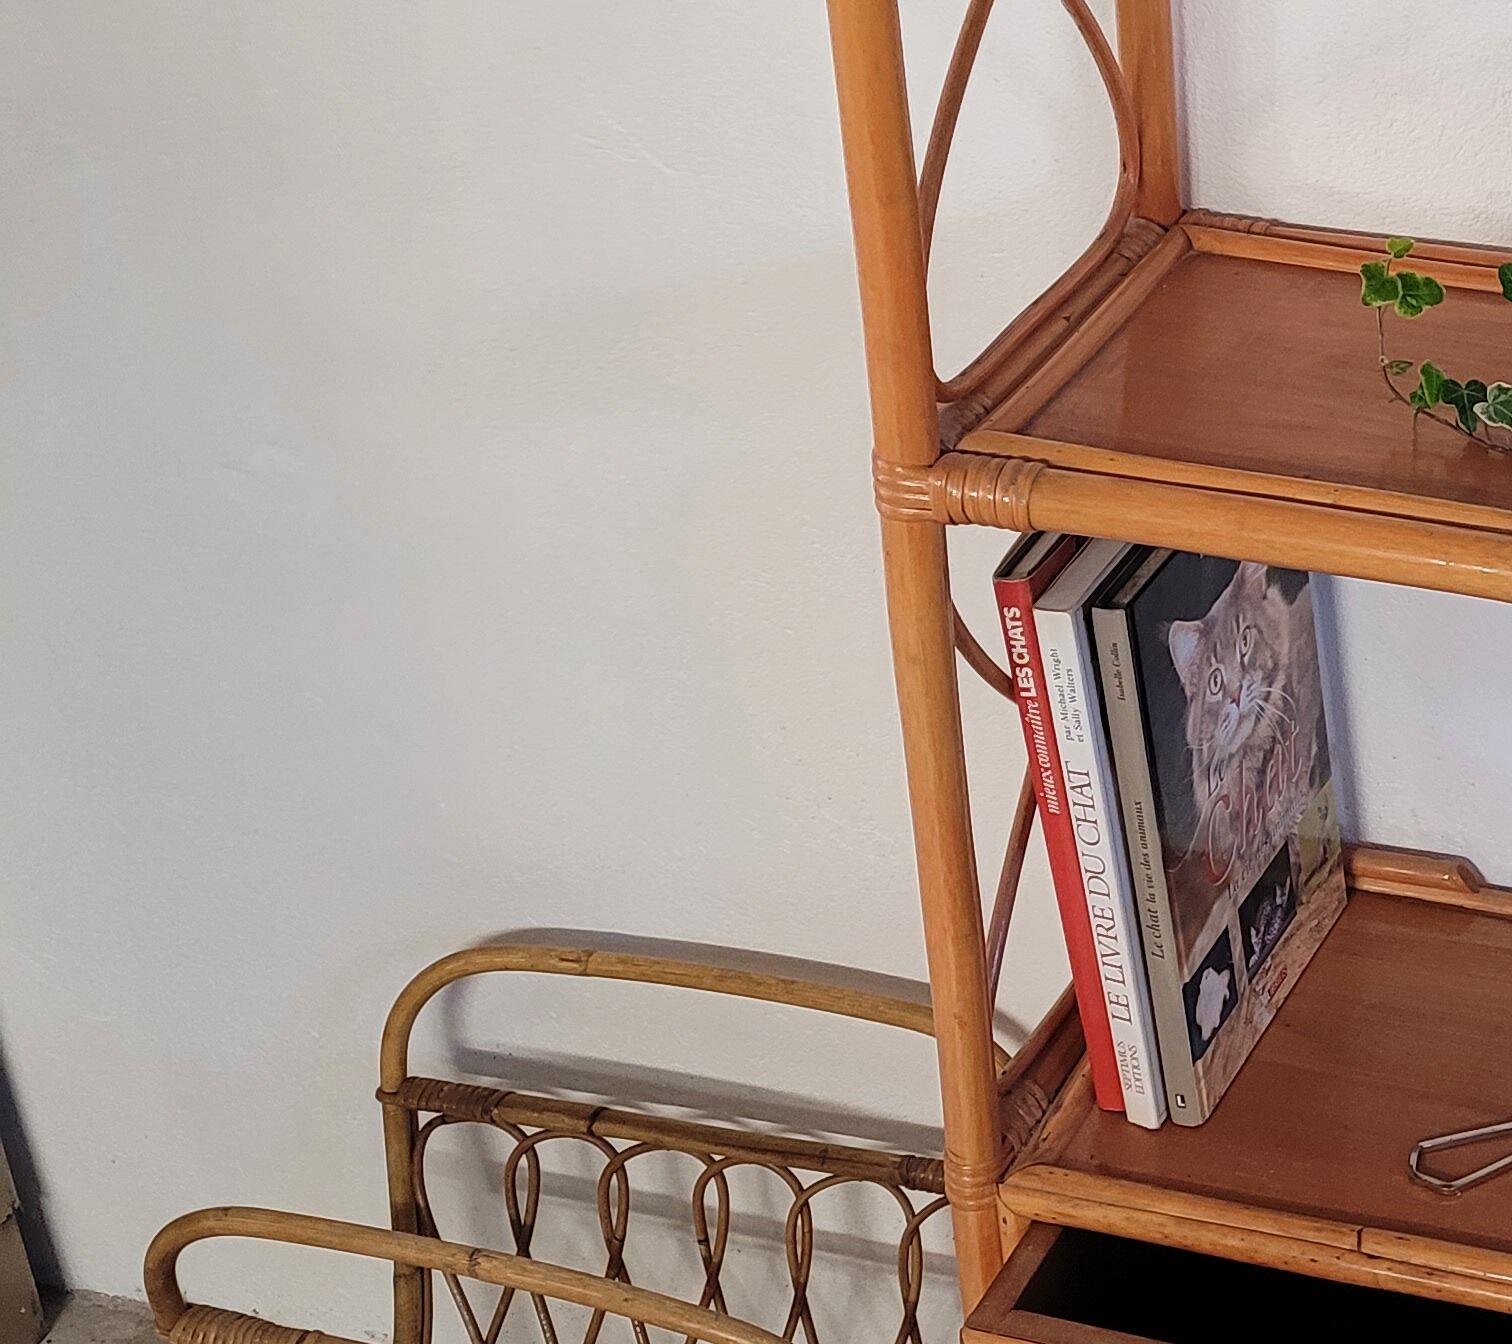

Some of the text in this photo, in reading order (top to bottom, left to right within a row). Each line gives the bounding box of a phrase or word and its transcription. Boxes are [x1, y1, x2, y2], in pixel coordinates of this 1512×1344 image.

[1003, 606, 1060, 815] mieux connaître LES CHATS
[1049, 648, 1075, 742] par Michael Wright
[1066, 668, 1085, 743] et Sally Walters
[1205, 719, 1303, 887] Chat
[1207, 759, 1227, 802] Le
[1065, 760, 1133, 1026] LE LIVRE DU CHAT
[1133, 799, 1166, 961] Le chat la vie des animaux
